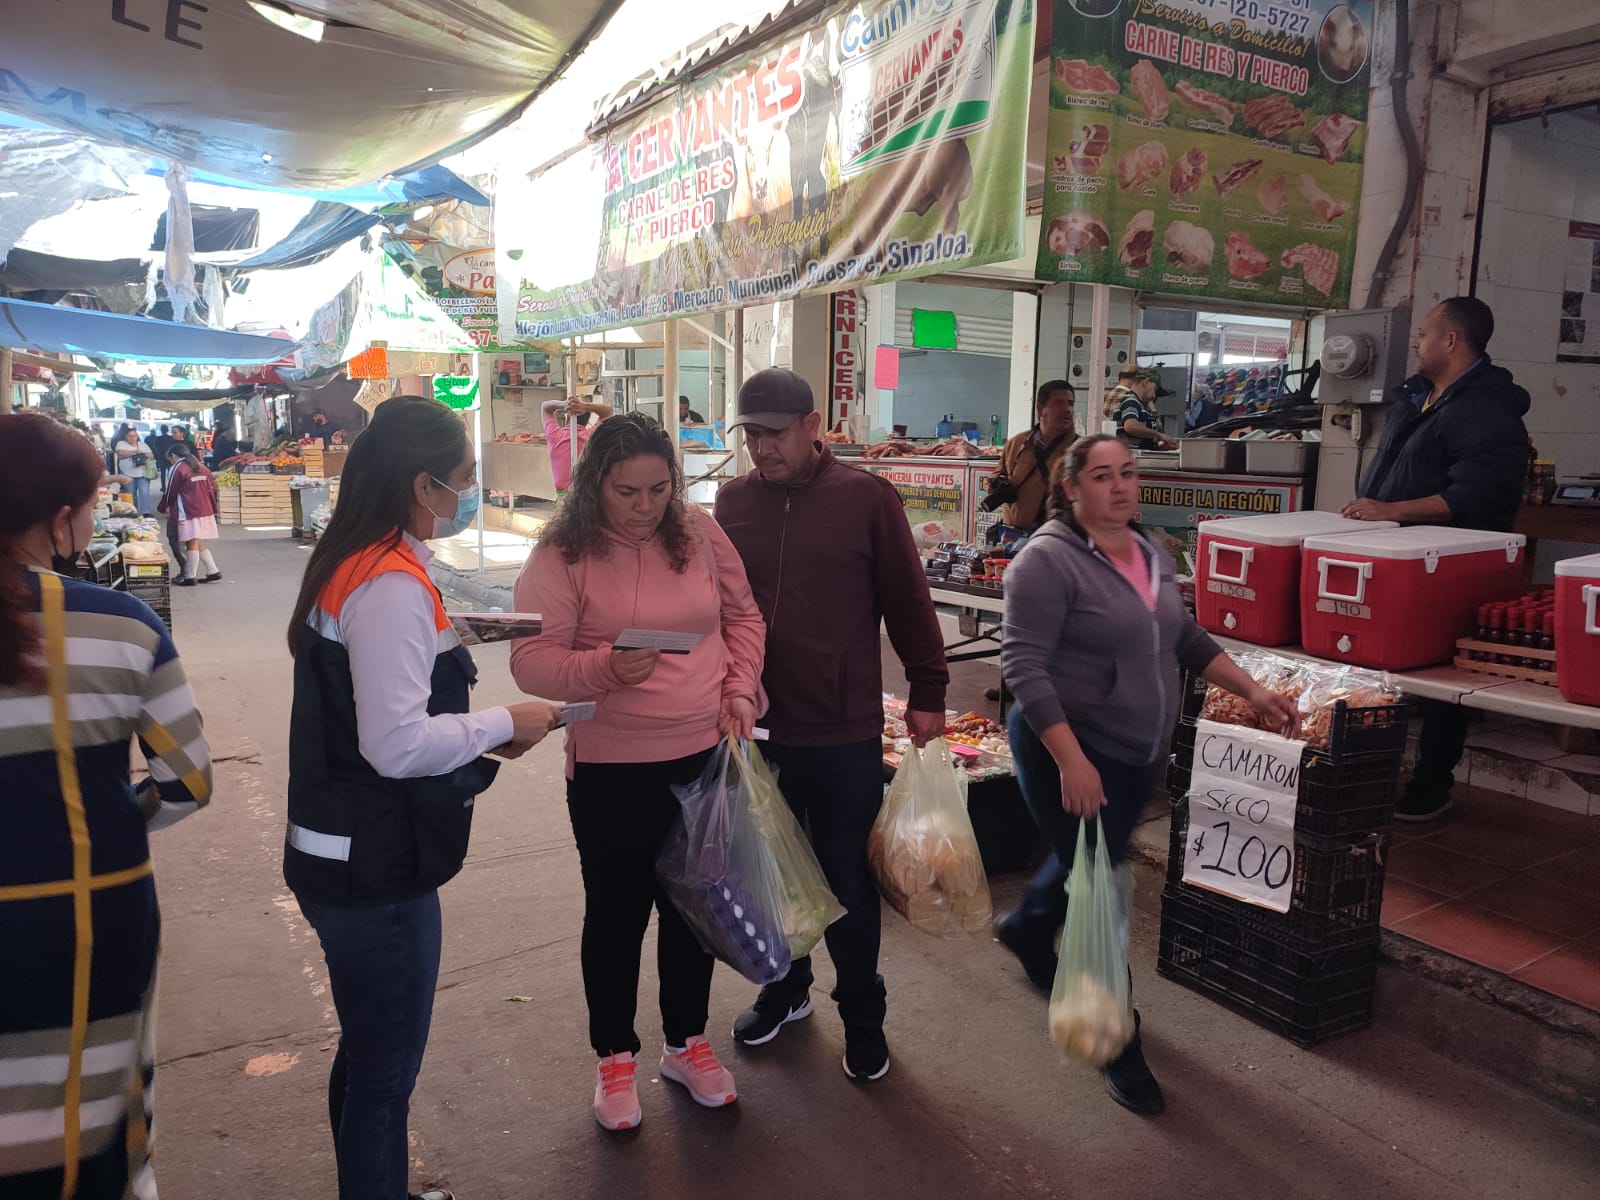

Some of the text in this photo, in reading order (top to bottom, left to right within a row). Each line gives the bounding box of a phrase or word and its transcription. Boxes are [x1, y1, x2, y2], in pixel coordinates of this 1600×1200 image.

[1190, 0, 1310, 34] 7-120-5727
[1213, 21, 1226, 37] a
[1229, 19, 1310, 57] Domicilio!
[874, 18, 964, 98] CERVANTES
[1126, 21, 1308, 95] CARNE DE RES Y PUERCO
[628, 48, 802, 181] CERVANTES
[618, 160, 735, 225] CARNE DE RES
[636, 225, 645, 247] Y
[650, 201, 715, 243] PUERCO
[621, 302, 645, 320] Local
[673, 285, 724, 310] Mercado
[888, 233, 972, 269] Sinaloa.
[914, 473, 954, 485] CERVANTES
[1137, 486, 1281, 513] ARNE DE LA REGIÓN!
[1202, 735, 1299, 788] CAMARON
[1207, 789, 1270, 824] SECO
[1192, 821, 1292, 889] $100
